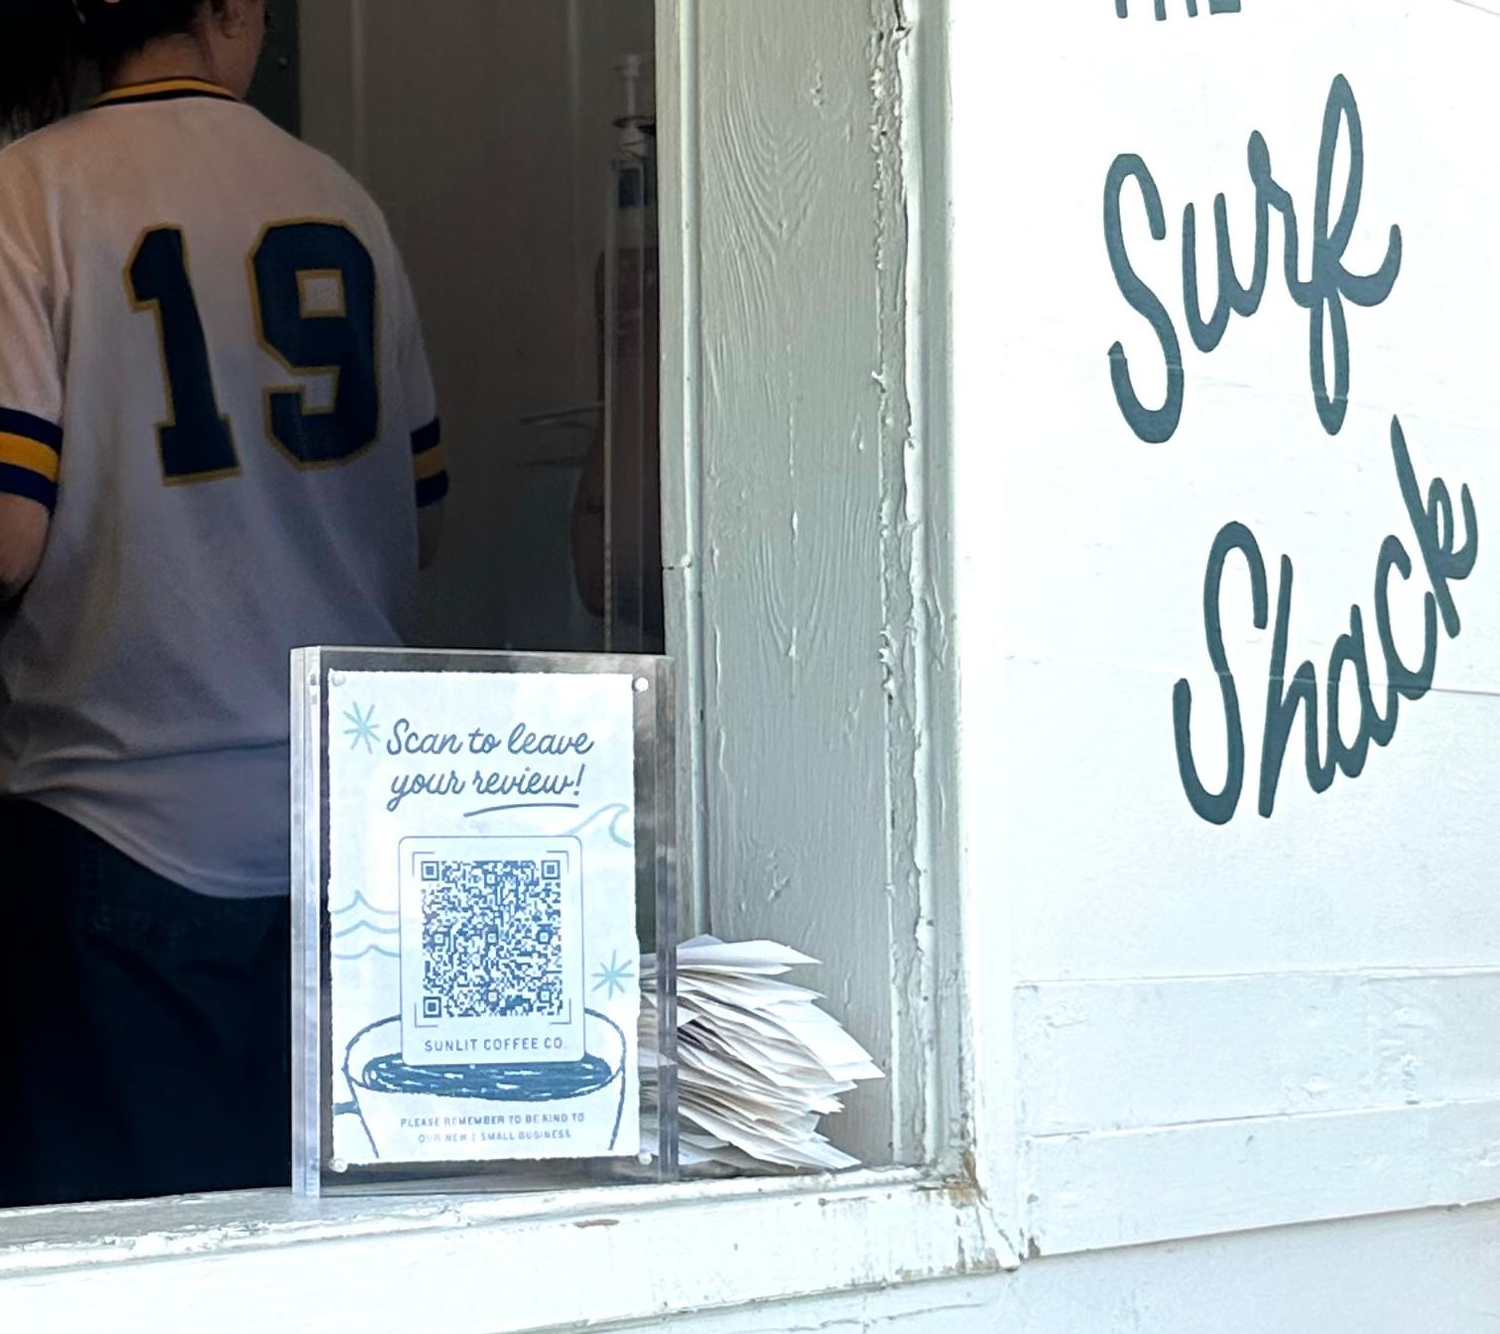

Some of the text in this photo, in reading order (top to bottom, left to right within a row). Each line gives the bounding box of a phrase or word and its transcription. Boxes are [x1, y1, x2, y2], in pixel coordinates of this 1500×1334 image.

[1103, 73, 1403, 444] Surf
[123, 215, 382, 487] 19
[1172, 413, 1478, 825] Shack
[386, 717, 595, 755] Scan to leave
[386, 763, 586, 812] your review!
[424, 1039, 478, 1052] SUNLIT
[483, 1037, 539, 1051] COFFEE
[400, 1117, 440, 1128] PLEASE
[444, 1115, 505, 1126] REMEMBER
[481, 1130, 515, 1142] SMALL
